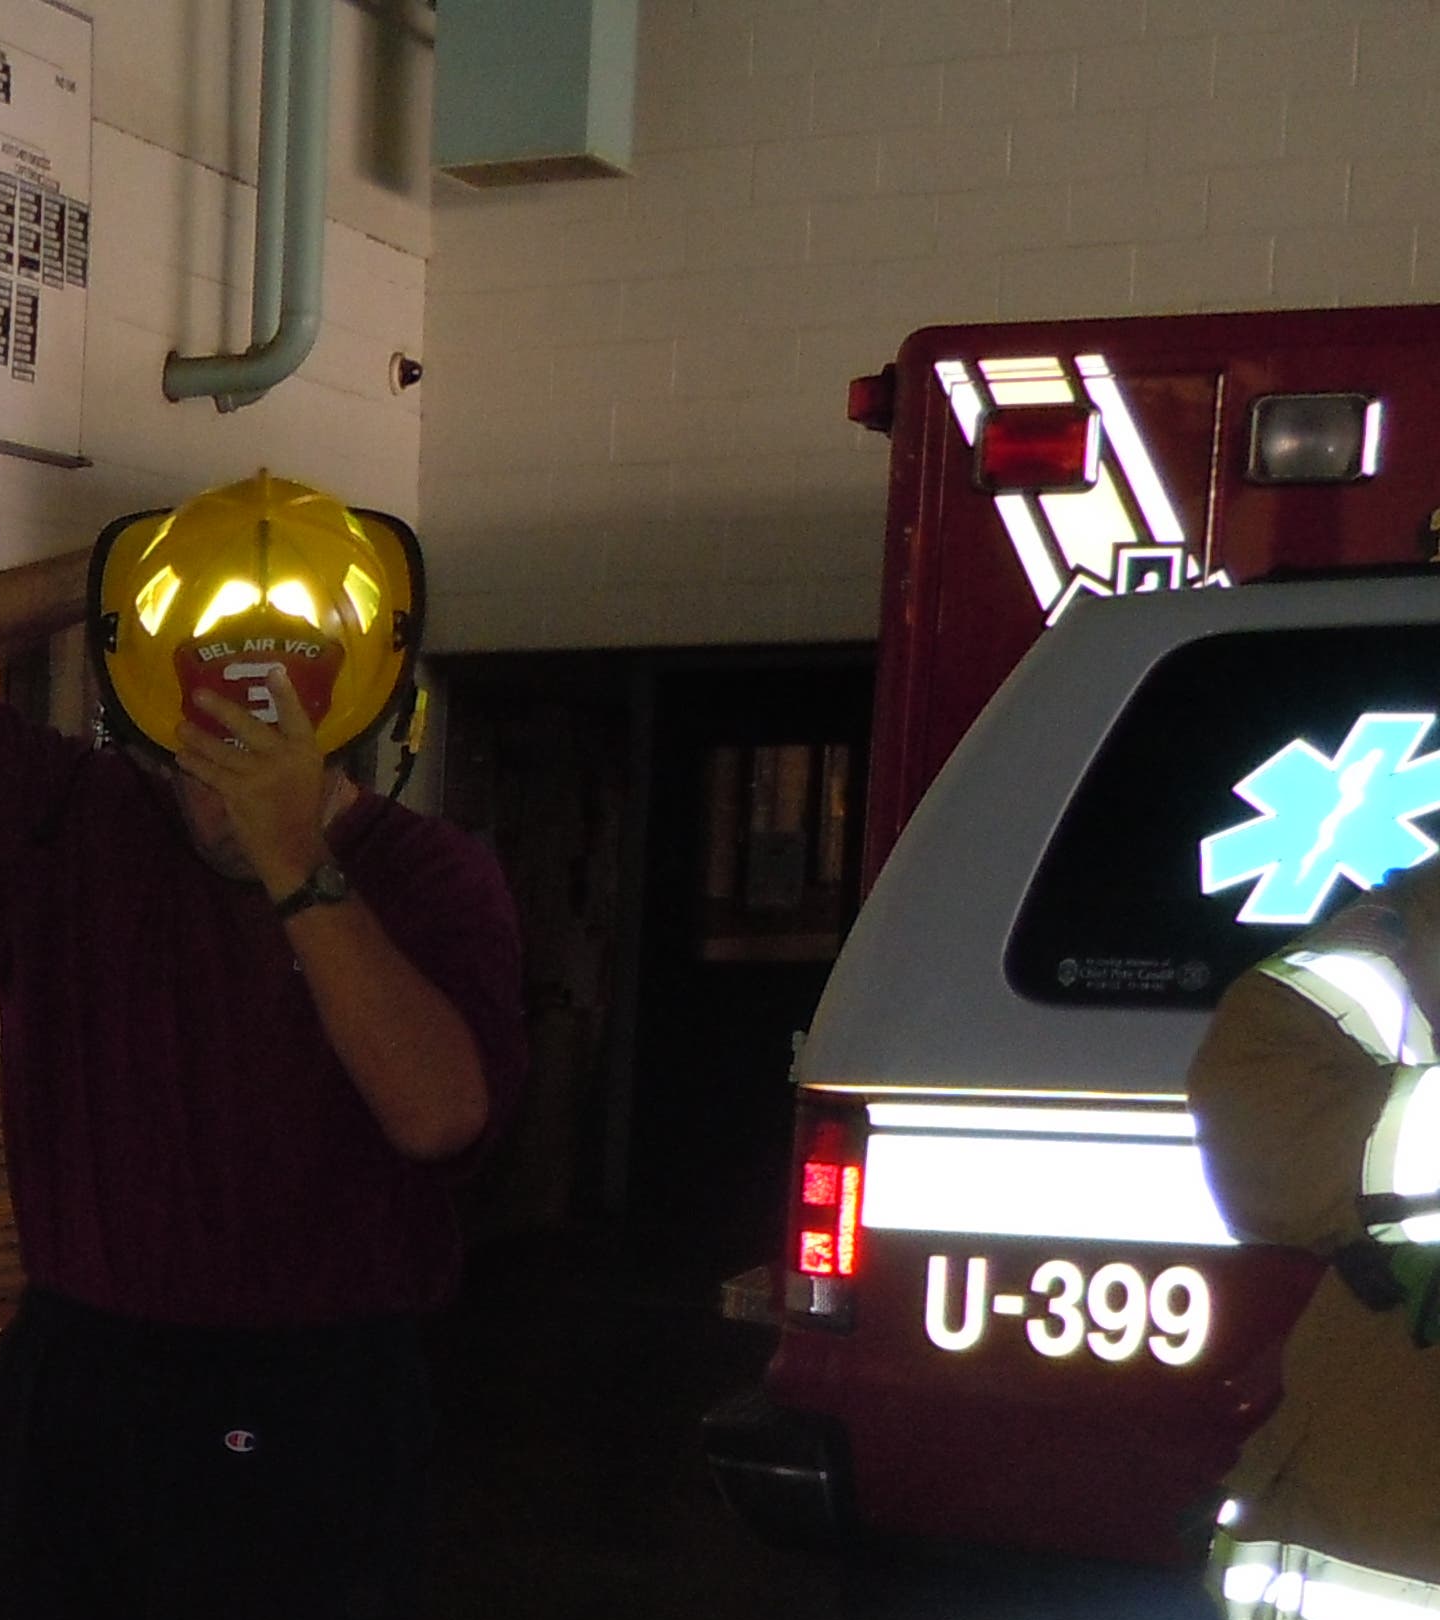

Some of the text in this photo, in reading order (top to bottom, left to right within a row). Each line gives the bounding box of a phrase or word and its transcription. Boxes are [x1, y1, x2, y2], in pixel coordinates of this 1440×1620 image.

[198, 638, 322, 662] BEL AIR VFC
[925, 1254, 1211, 1367] U-399
